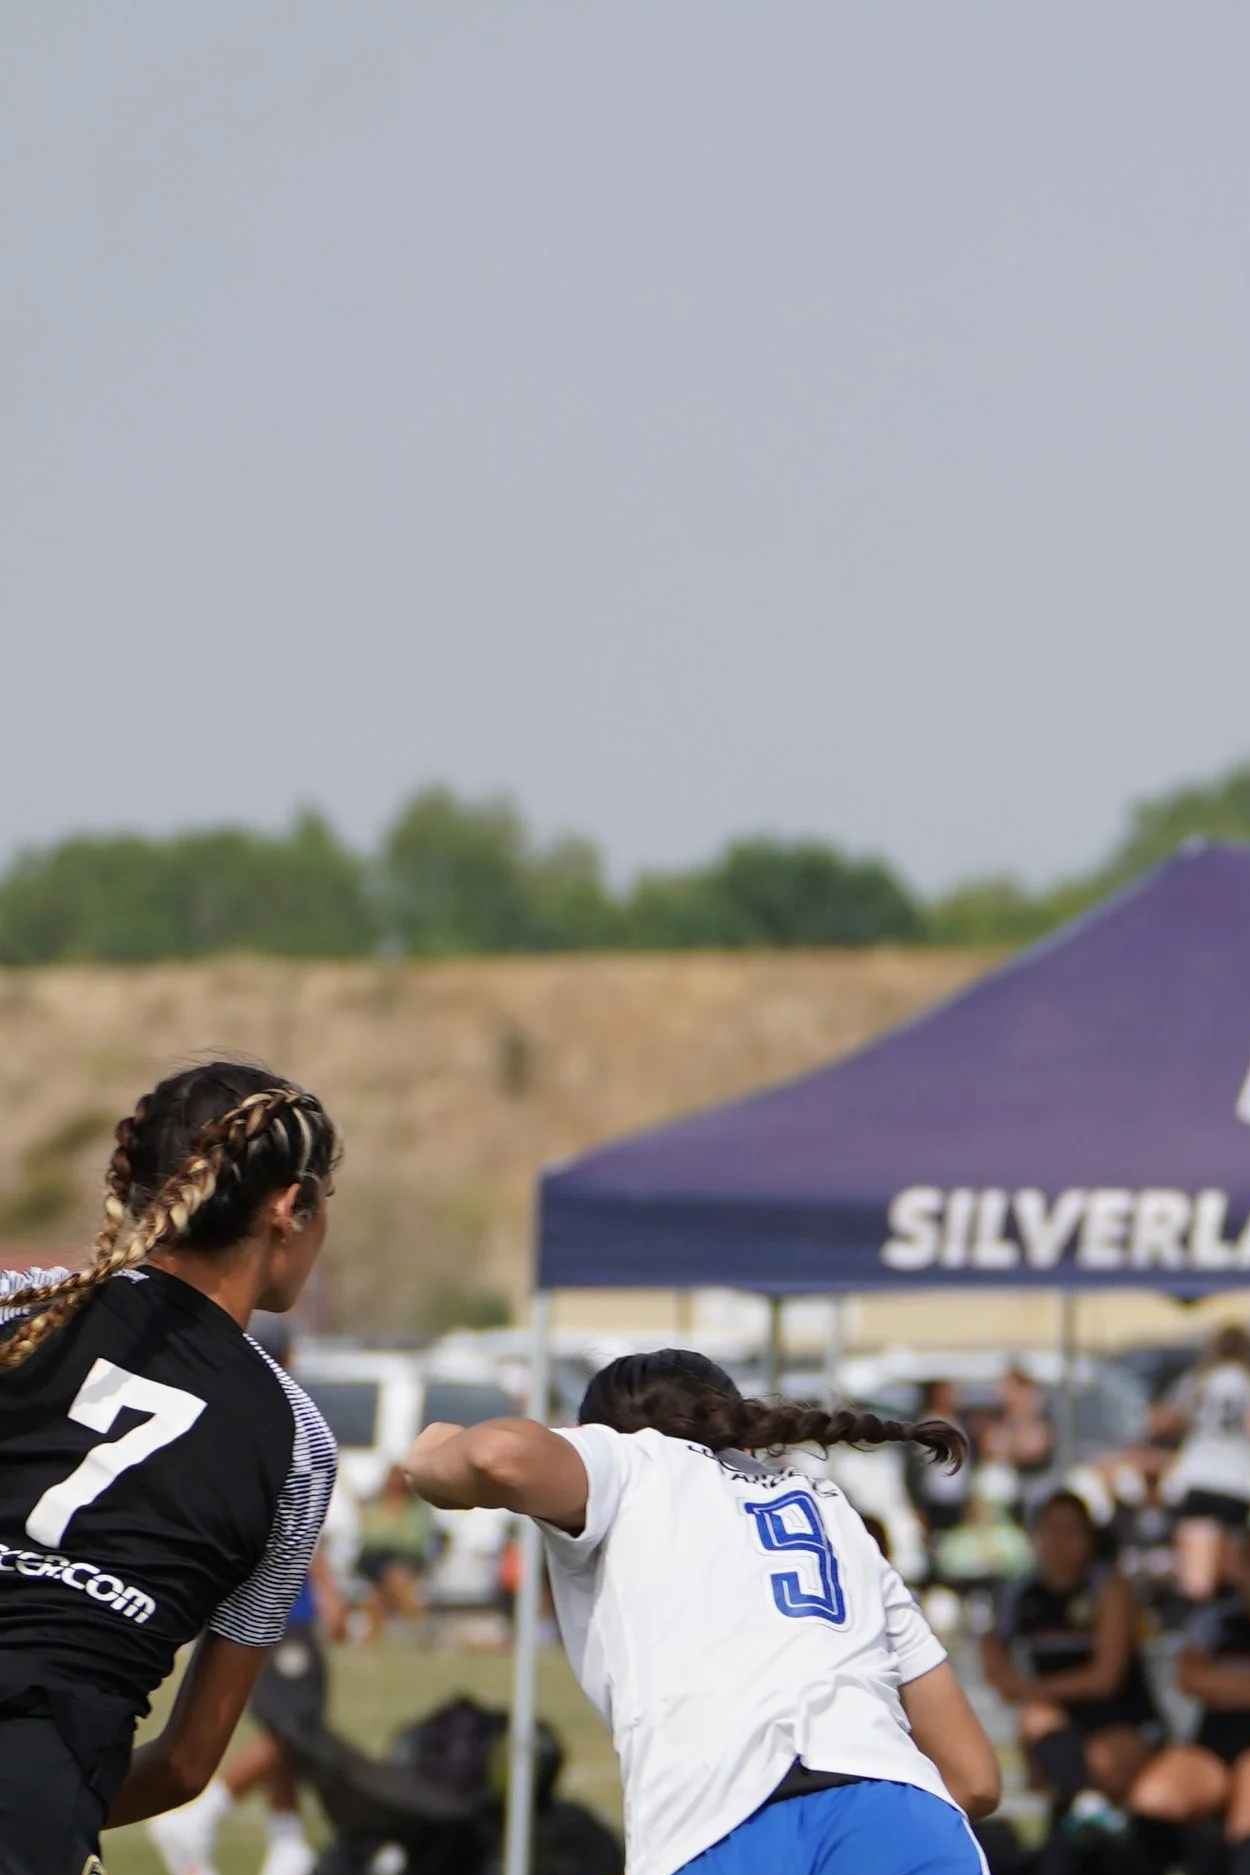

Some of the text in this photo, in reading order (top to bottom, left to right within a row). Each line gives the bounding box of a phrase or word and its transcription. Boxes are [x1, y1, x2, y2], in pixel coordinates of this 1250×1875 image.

[26, 1356, 208, 1549] 7
[0, 1543, 156, 1624] CER.COM
[744, 1489, 846, 1625] 9
